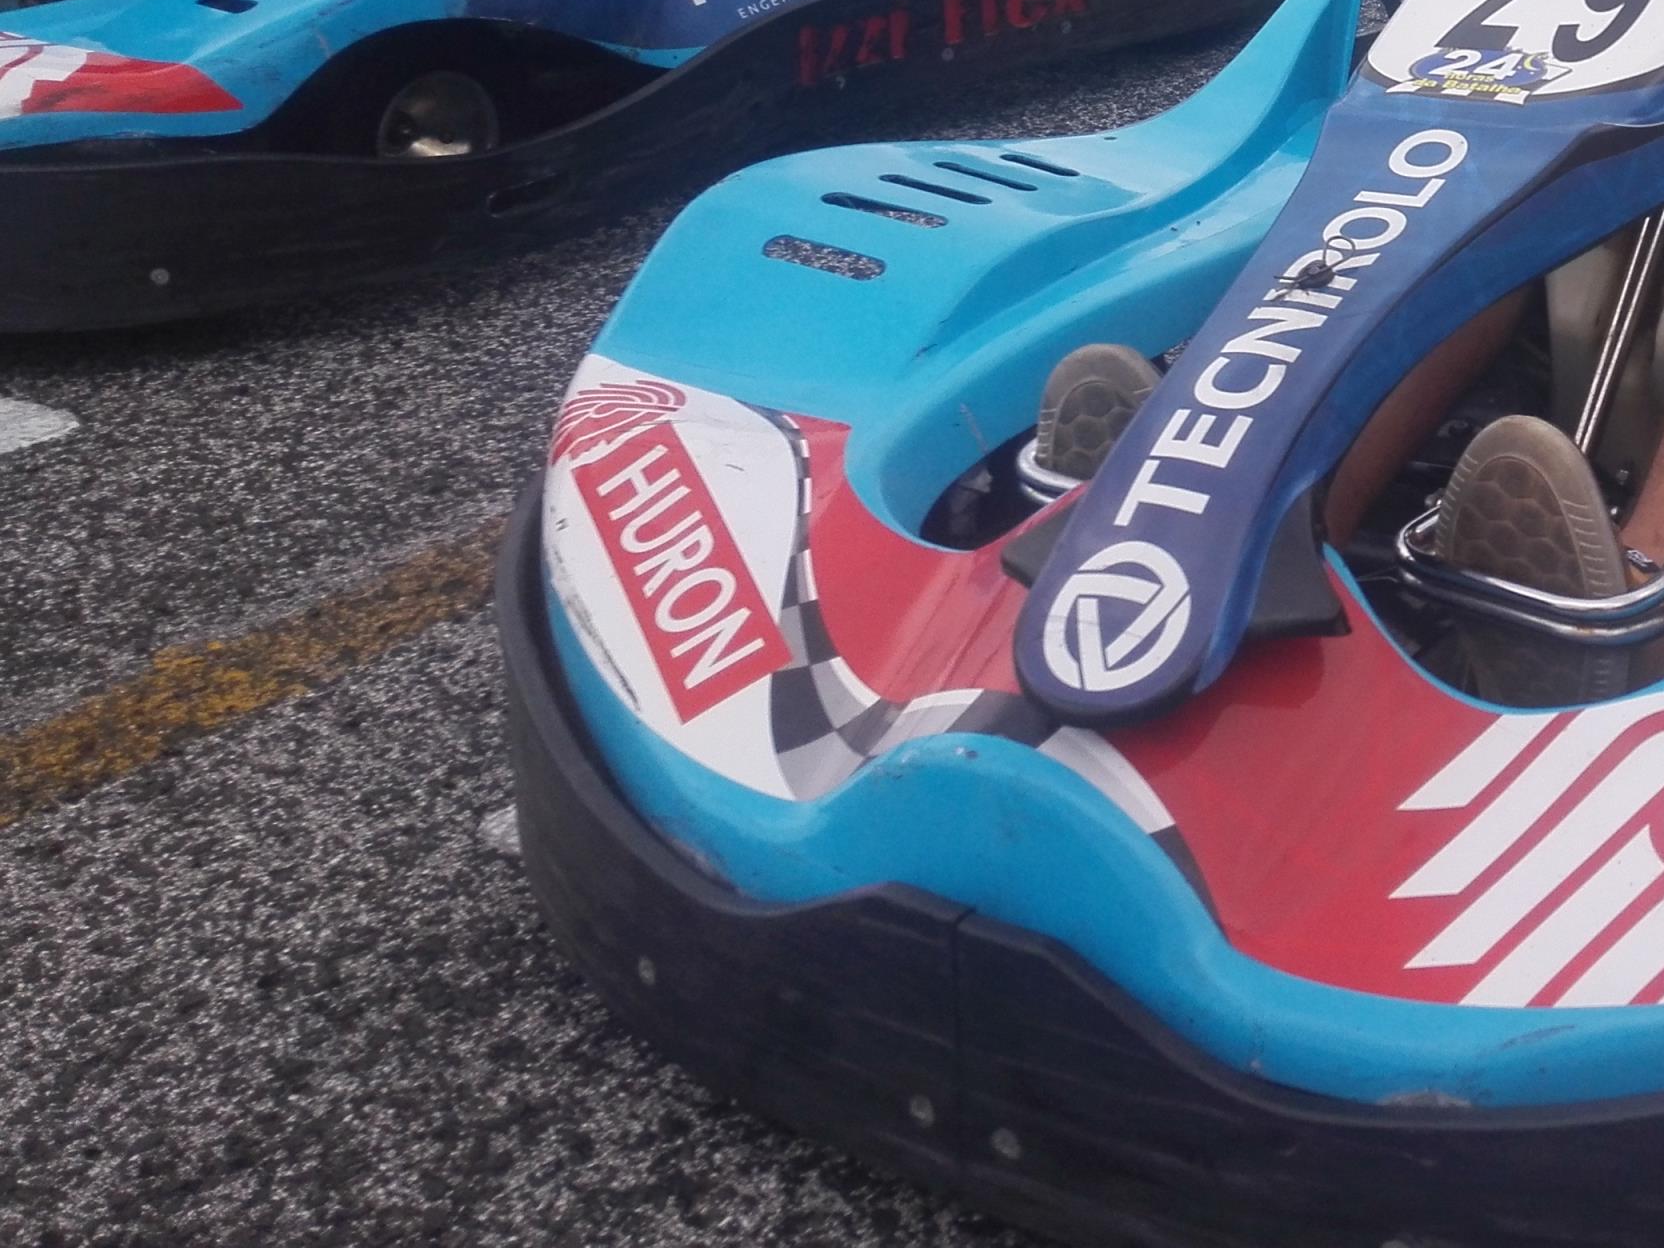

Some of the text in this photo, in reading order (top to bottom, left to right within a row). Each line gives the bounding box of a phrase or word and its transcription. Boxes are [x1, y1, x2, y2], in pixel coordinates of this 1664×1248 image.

[1428, 49, 1524, 80] 24
[1114, 129, 1469, 527] TECNIROLO
[596, 443, 765, 690] HURON
